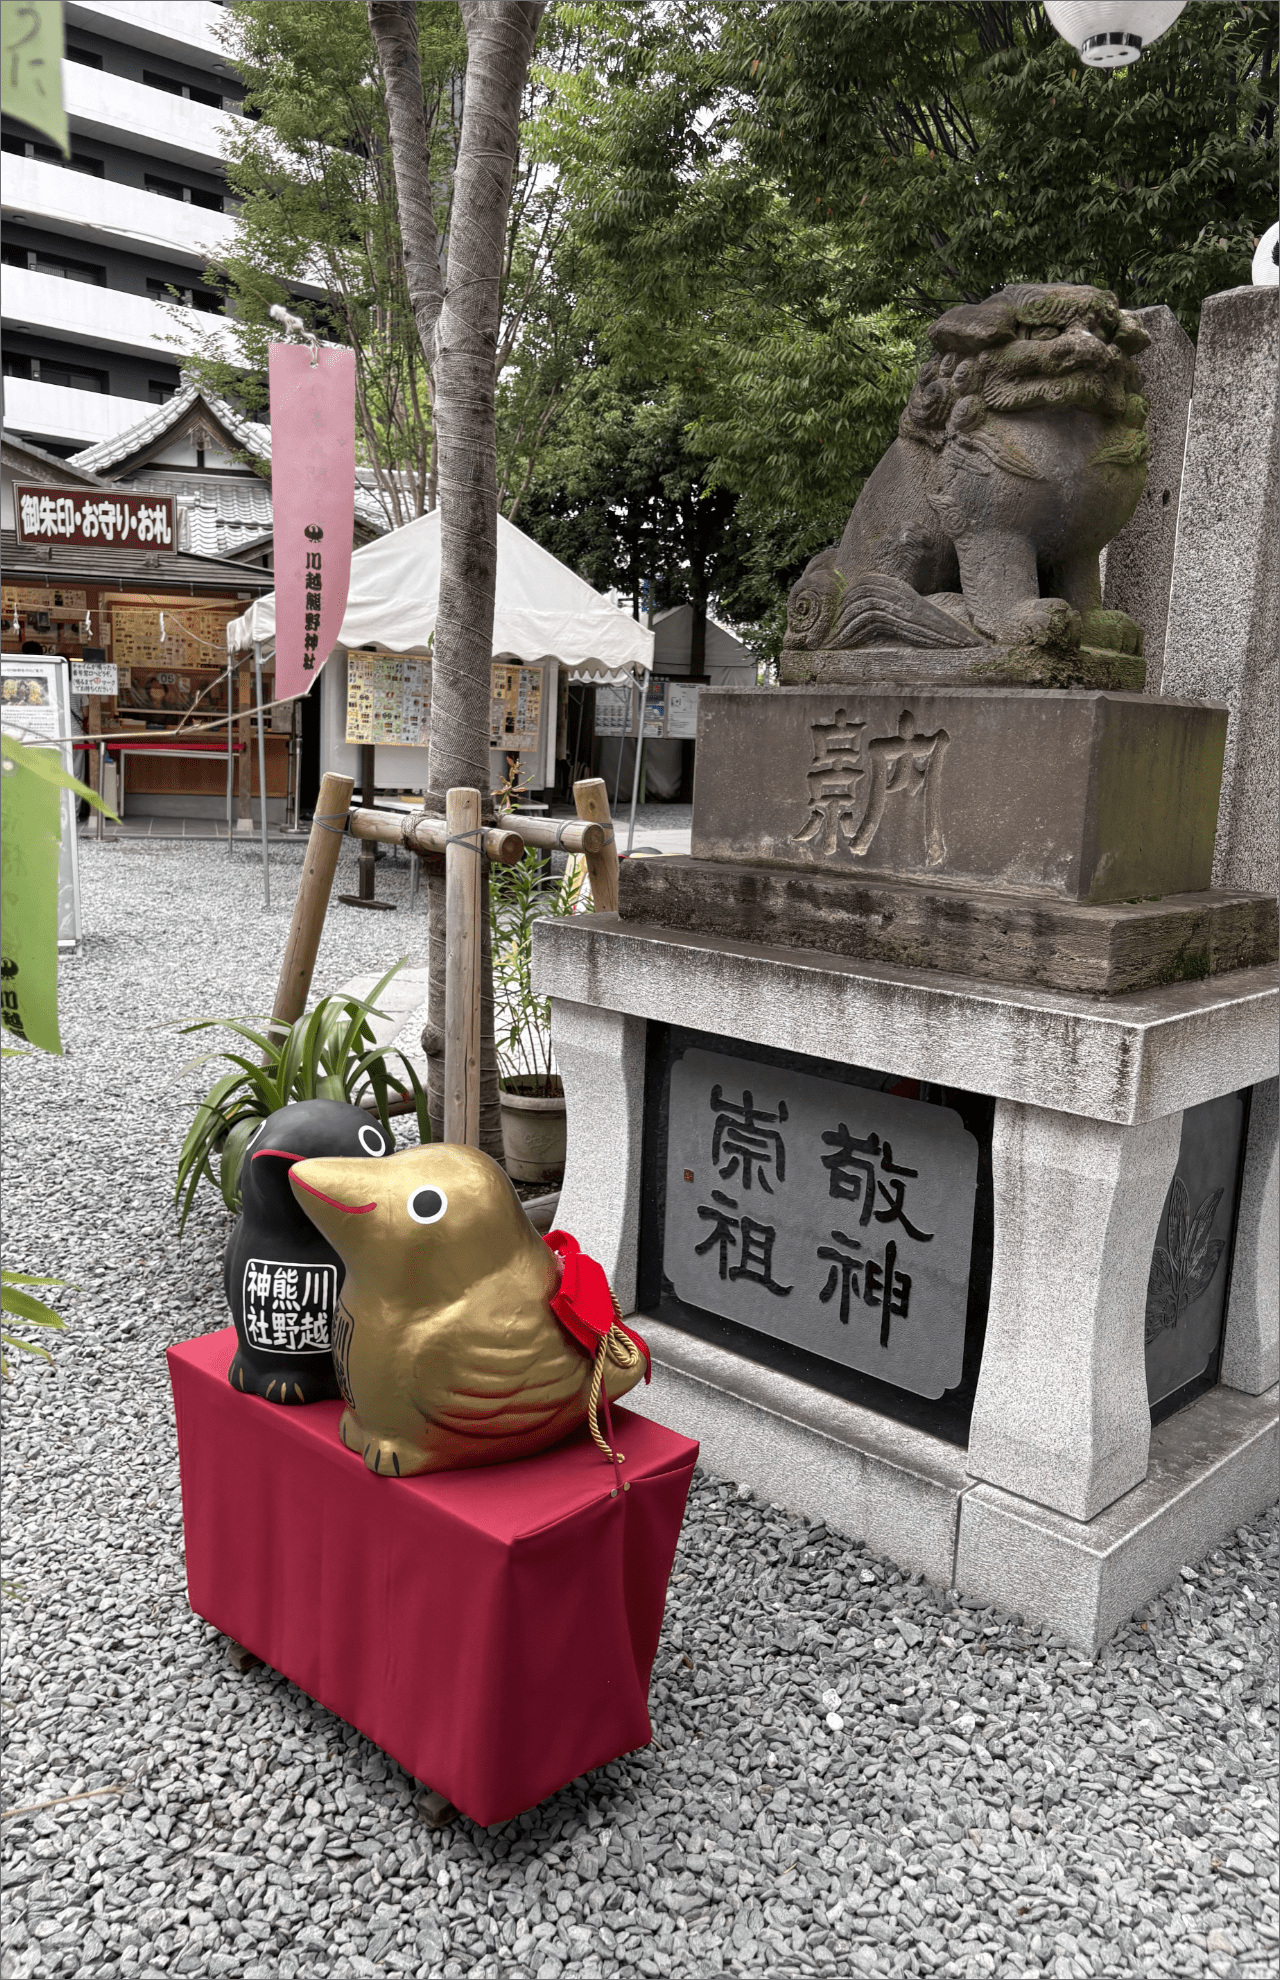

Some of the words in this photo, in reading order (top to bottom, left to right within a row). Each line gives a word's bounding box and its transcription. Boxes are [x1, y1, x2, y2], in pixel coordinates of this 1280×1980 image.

[20, 494, 171, 544] 御朱印・お守り・お札
[303, 552, 322, 670] 川越熊野神社
[160, 674, 174, 683] 05
[694, 1083, 795, 1296] 崇祖
[816, 1122, 935, 1349] 敬神
[247, 1262, 273, 1345] 神社
[271, 1267, 302, 1350] 熊野
[297, 1270, 332, 1349] 川越
